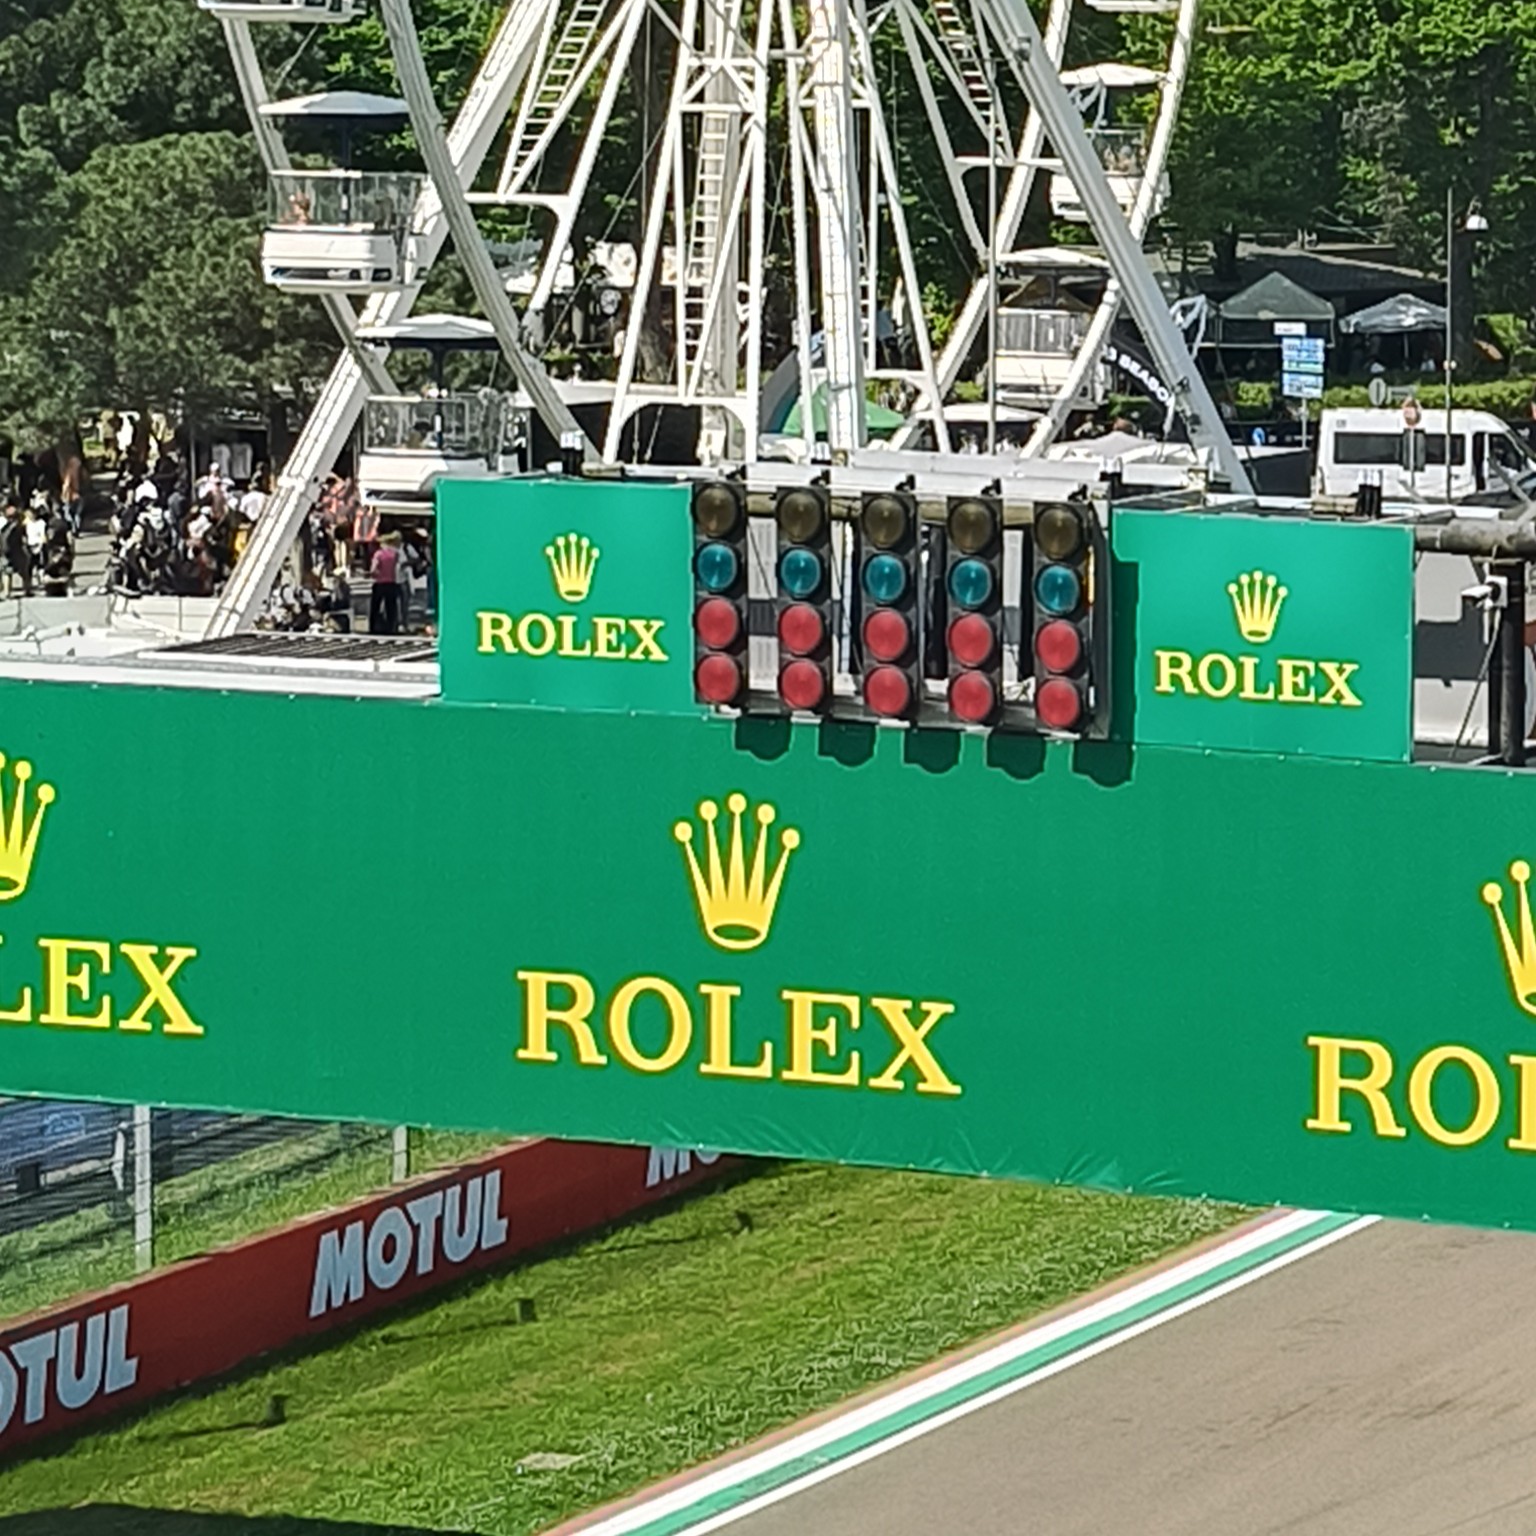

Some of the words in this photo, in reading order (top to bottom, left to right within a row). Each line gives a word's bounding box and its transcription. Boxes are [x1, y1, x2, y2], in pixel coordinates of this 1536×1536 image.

[476, 611, 669, 662] ROLEX
[1154, 648, 1362, 708] ROLEX
[516, 970, 962, 1097] ROLEX
[310, 1170, 508, 1319] MOTUL
